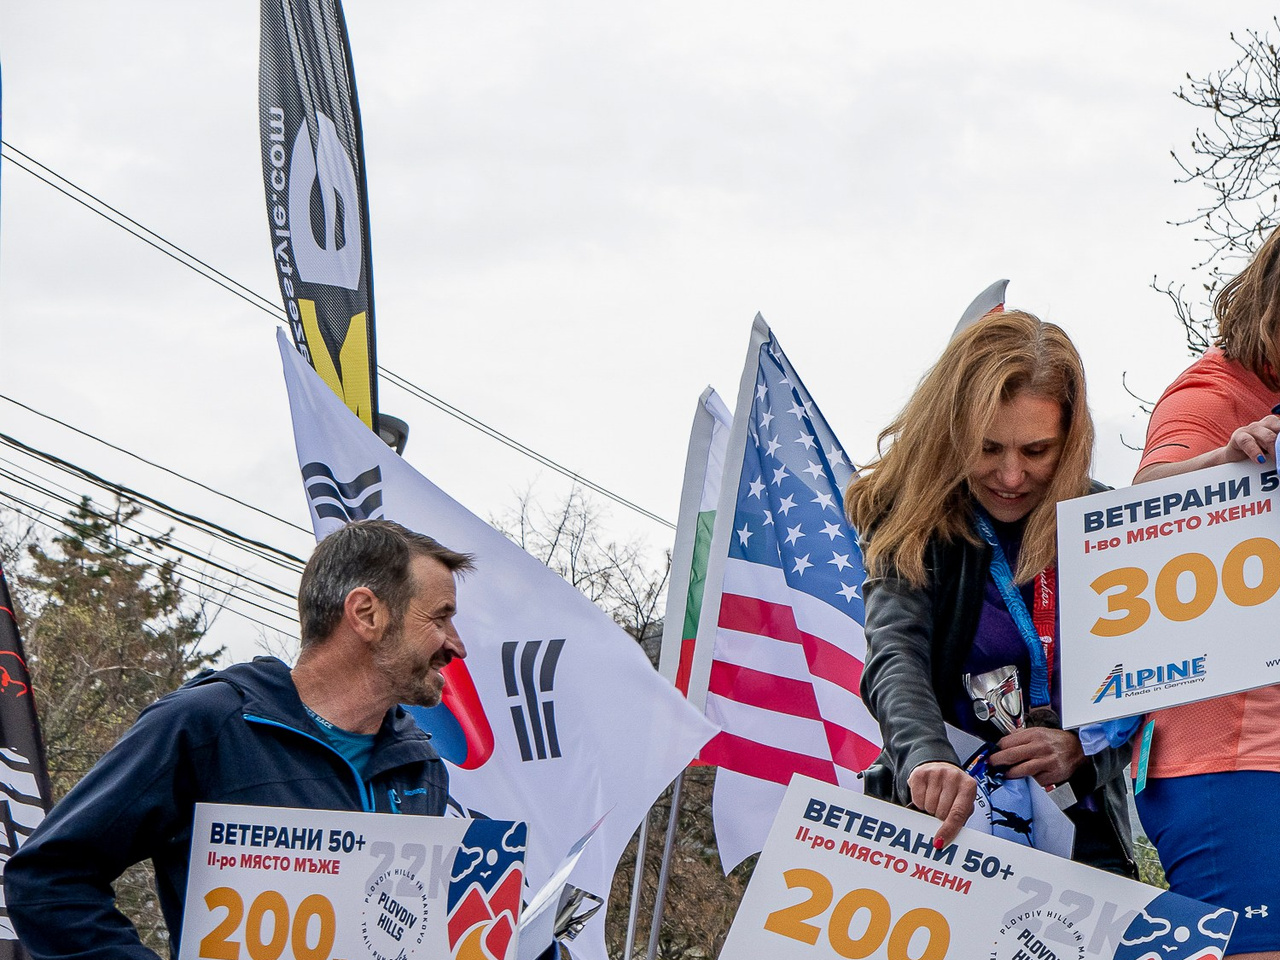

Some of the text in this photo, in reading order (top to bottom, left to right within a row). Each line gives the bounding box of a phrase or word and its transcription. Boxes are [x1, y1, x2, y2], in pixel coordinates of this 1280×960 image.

[1084, 476, 1250, 533] ВЕТЕРАНИ
[1127, 515, 1201, 544] МЯСТО
[1207, 498, 1272, 527] ЖЕНИ
[1090, 657, 1207, 704] ALPINE
[1125, 688, 1151, 698] Made
[1164, 677, 1206, 690] Germany
[210, 822, 366, 853] ВЕТЕРАНИ 50+
[803, 798, 1014, 880] ВЕТЕРАНИ 50+
[240, 854, 290, 872] МЯСТО
[294, 857, 341, 875] МЪЖЕ
[839, 840, 908, 874] МЯСТО
[910, 863, 972, 895] ЖЕНИ
[377, 913, 404, 942] HILLS
[378, 892, 417, 929] PLOVDIV
[1000, 910, 1042, 934] PLOVDIV
[1046, 911, 1074, 928] HILLS
